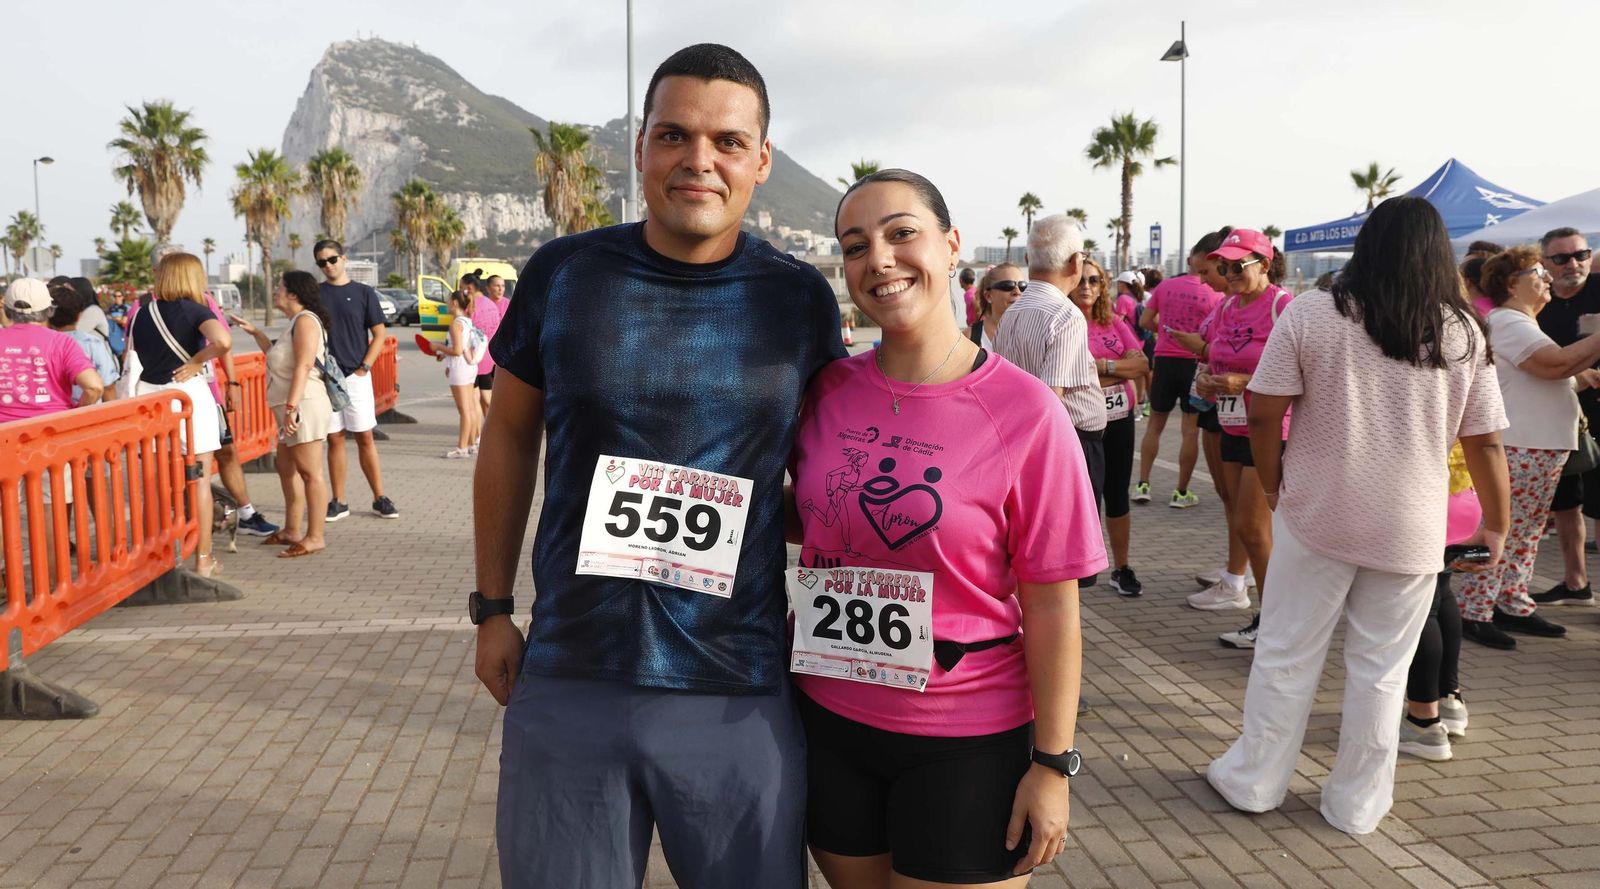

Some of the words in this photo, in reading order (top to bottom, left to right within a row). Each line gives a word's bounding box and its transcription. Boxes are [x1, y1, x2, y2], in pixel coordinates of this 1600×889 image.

[1310, 229, 1325, 242] MTB
[1326, 227, 1339, 240] LOS
[772, 255, 800, 270] DOMYOS
[1105, 394, 1124, 410] 54
[1216, 396, 1237, 413] 77
[838, 431, 866, 443] Algeciras
[905, 438, 944, 452] Diputación
[913, 446, 934, 457] Cádiz
[669, 468, 740, 494] CARRERA
[629, 474, 661, 491] POR
[665, 480, 684, 496] LA
[689, 484, 743, 508] MUJER
[604, 490, 722, 552] 559
[871, 503, 921, 531] Apron
[668, 549, 687, 557] ADRIAN
[858, 570, 921, 589] CARRERA
[825, 579, 853, 594] POR
[857, 582, 873, 597] LA
[878, 583, 926, 603] MUJER
[812, 594, 912, 651] 286
